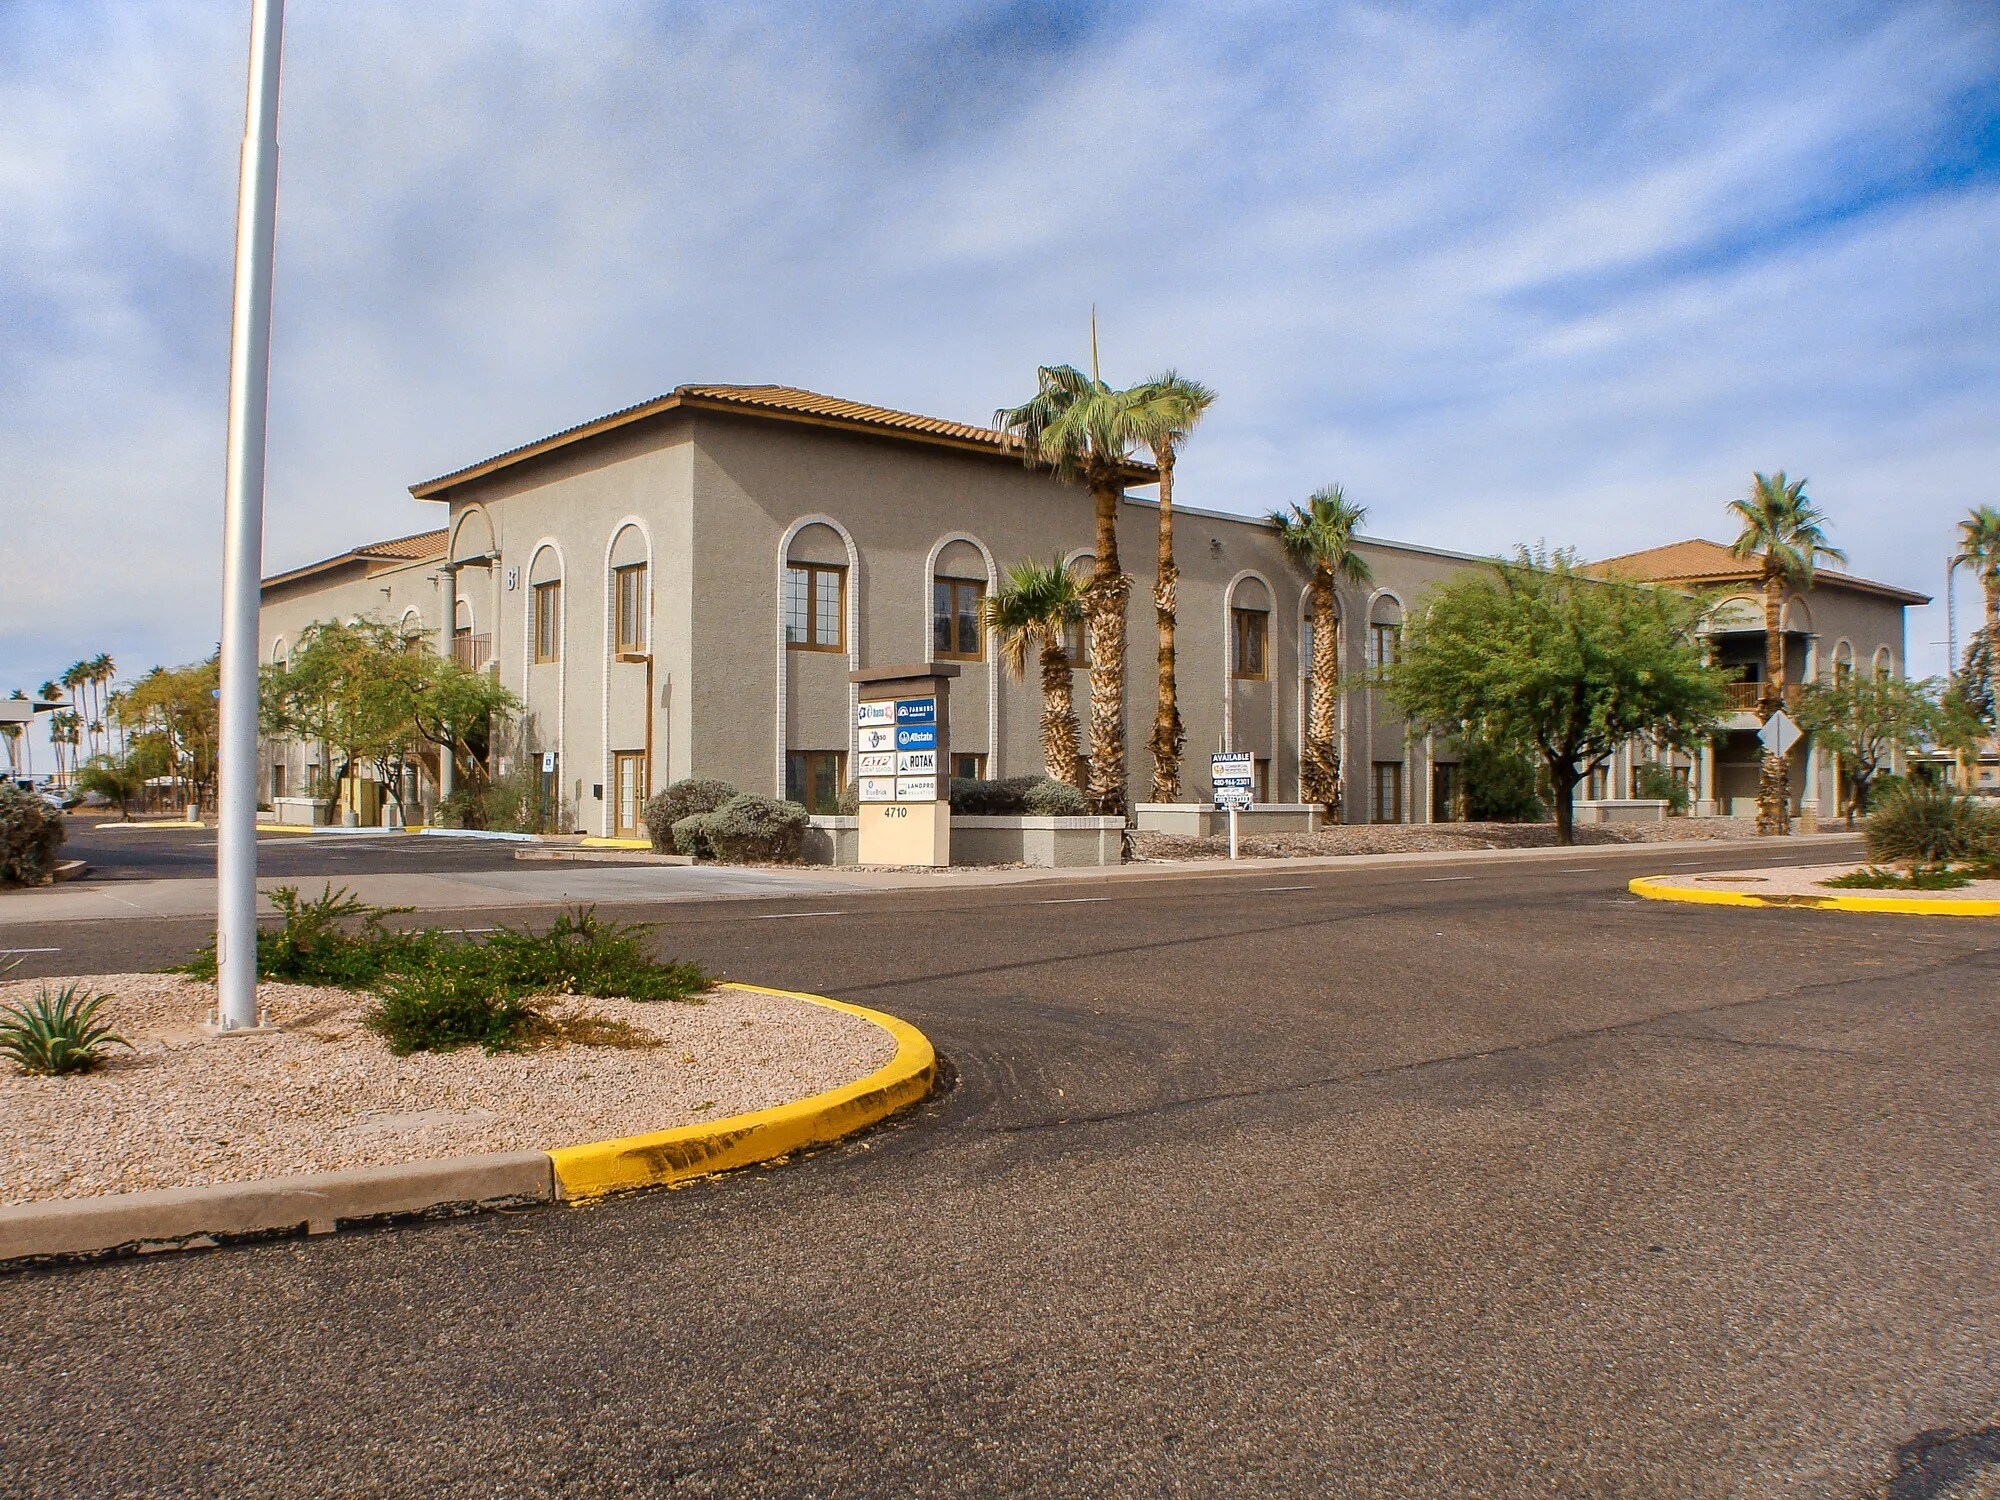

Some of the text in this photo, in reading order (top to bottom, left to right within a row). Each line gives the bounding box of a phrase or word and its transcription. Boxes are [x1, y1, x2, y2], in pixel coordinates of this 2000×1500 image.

[910, 732, 933, 742] Allstate
[910, 754, 934, 768] ROTAK
[1213, 753, 1249, 761] AVAILABLE
[885, 807, 907, 818] 4710
